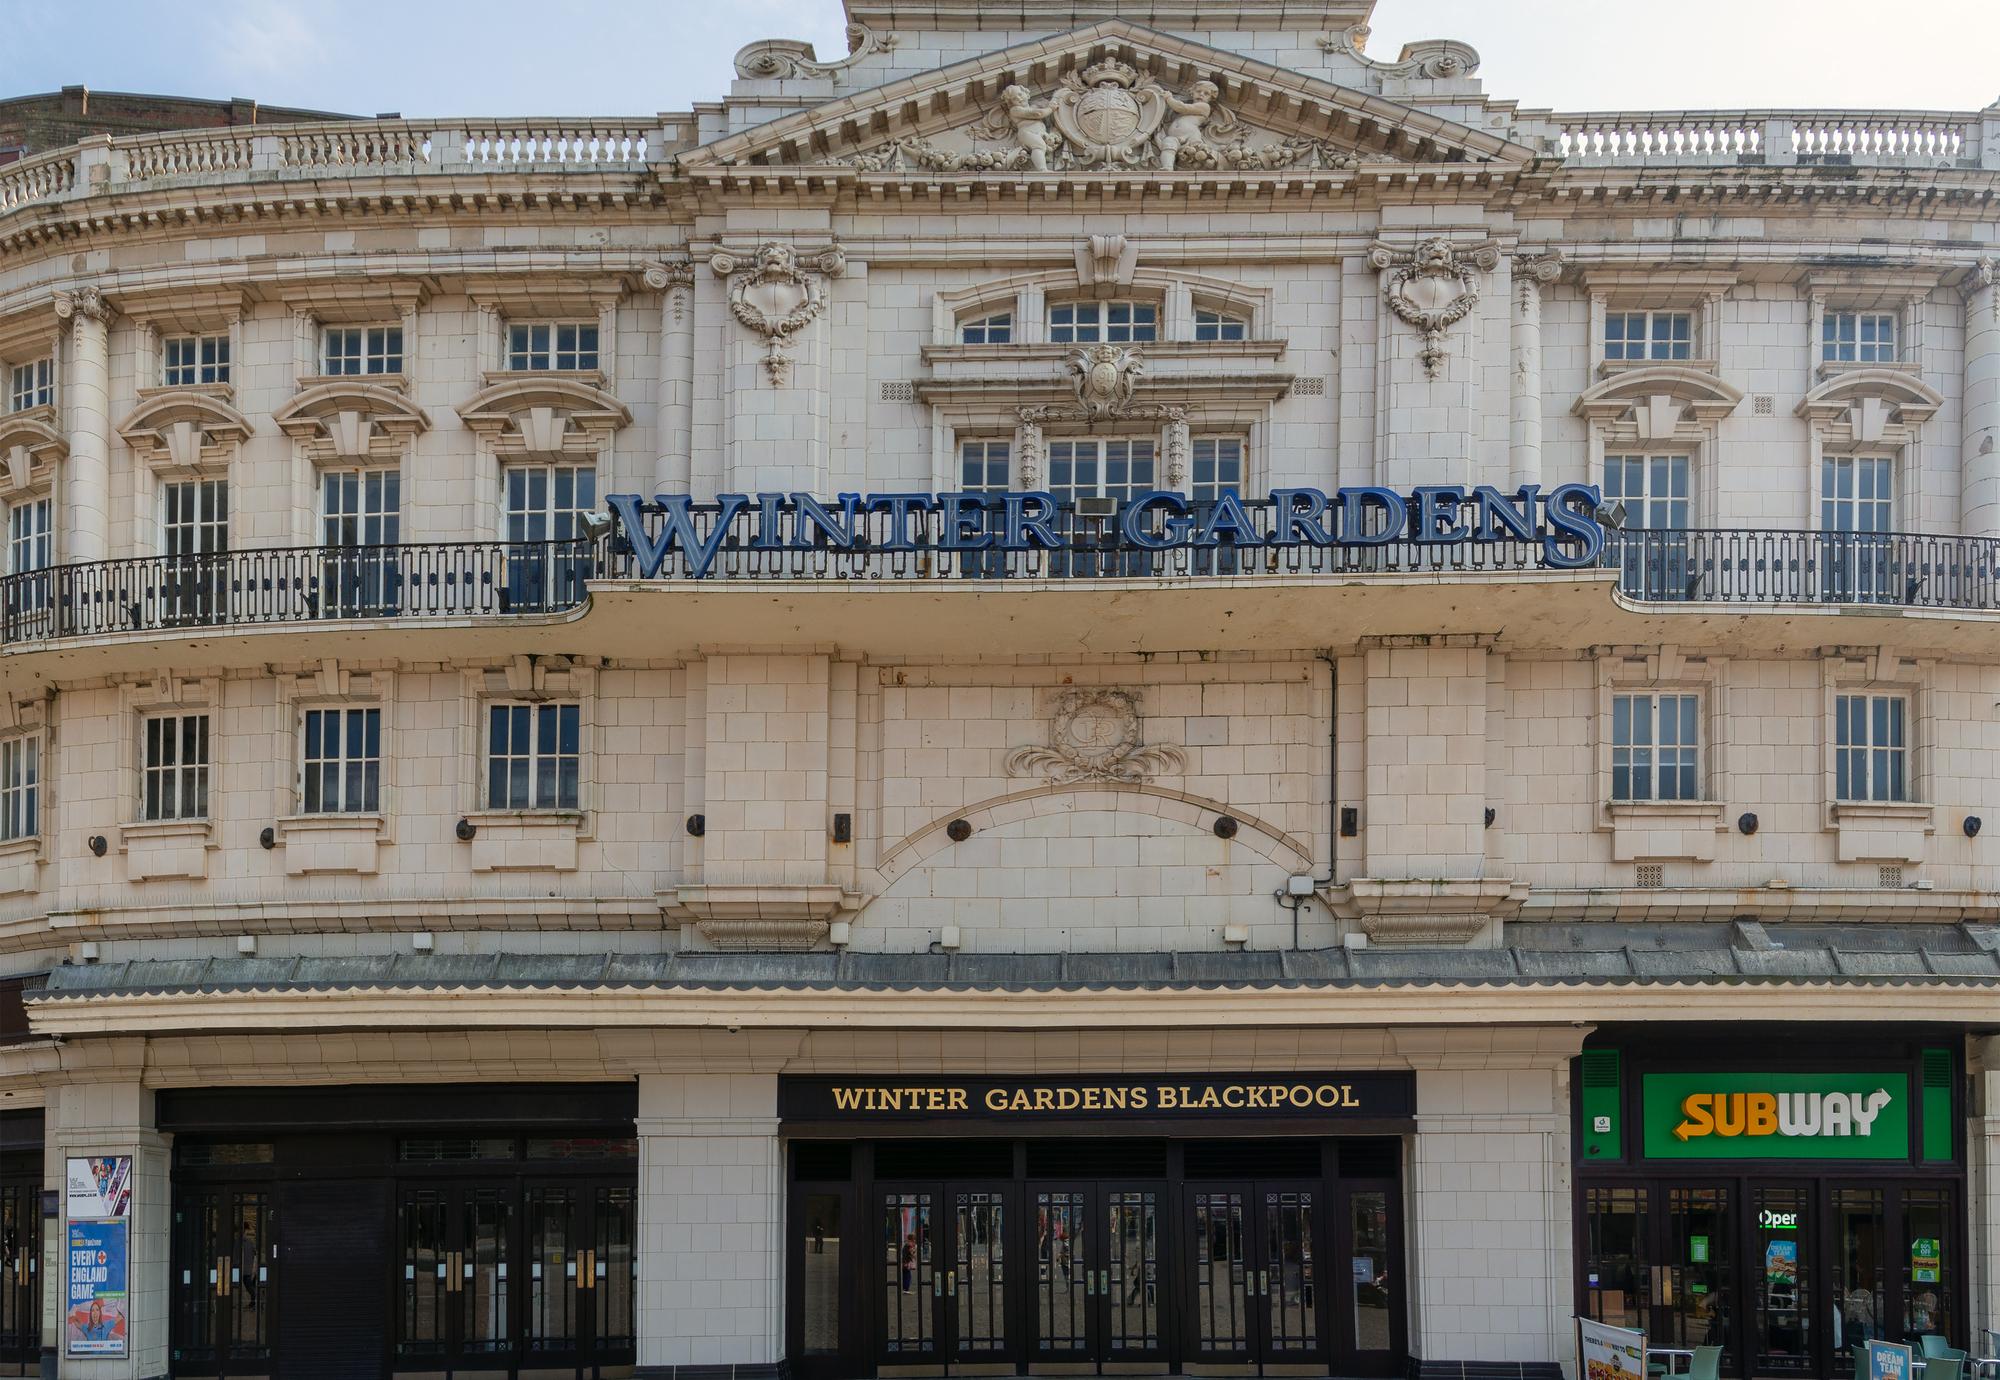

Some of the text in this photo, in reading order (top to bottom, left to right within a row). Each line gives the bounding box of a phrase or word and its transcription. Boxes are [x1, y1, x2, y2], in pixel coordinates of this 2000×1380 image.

[605, 483, 1604, 579] WINTER GARDENS
[832, 1084, 1360, 1111] WINTER GARDENS BLACKPOOL
[1673, 1088, 1893, 1141] SUBWAY
[71, 1250, 96, 1266] EVERY
[71, 1266, 108, 1283] ENGLAND
[71, 1283, 95, 1300] GAME
[1876, 1351, 1904, 1366] DREAM
[1880, 1362, 1902, 1376] TEAM
